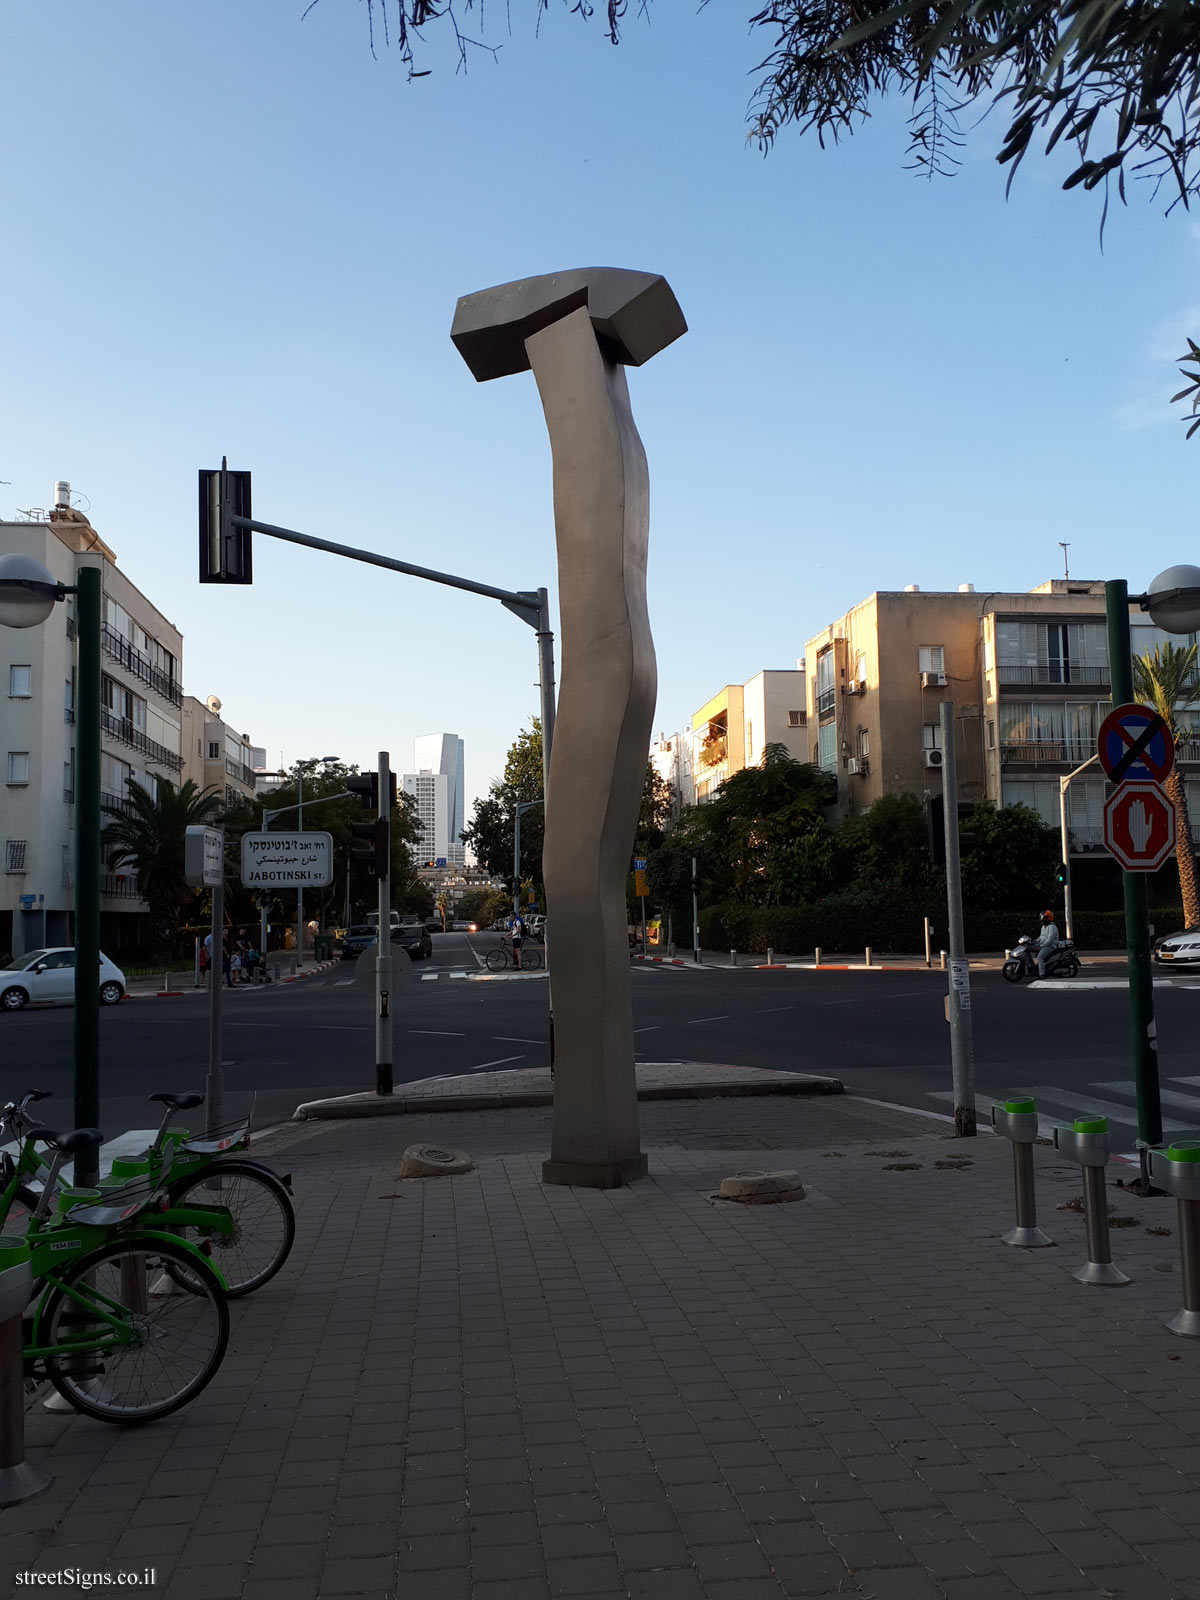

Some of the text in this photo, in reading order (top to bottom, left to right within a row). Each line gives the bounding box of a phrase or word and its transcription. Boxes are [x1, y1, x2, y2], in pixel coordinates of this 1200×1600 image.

[249, 840, 298, 853] ז'בוטינסקי
[299, 842, 312, 850] זאב
[256, 855, 317, 866] شارع جبوتينسكي
[249, 871, 311, 881] JABOTINSKI
